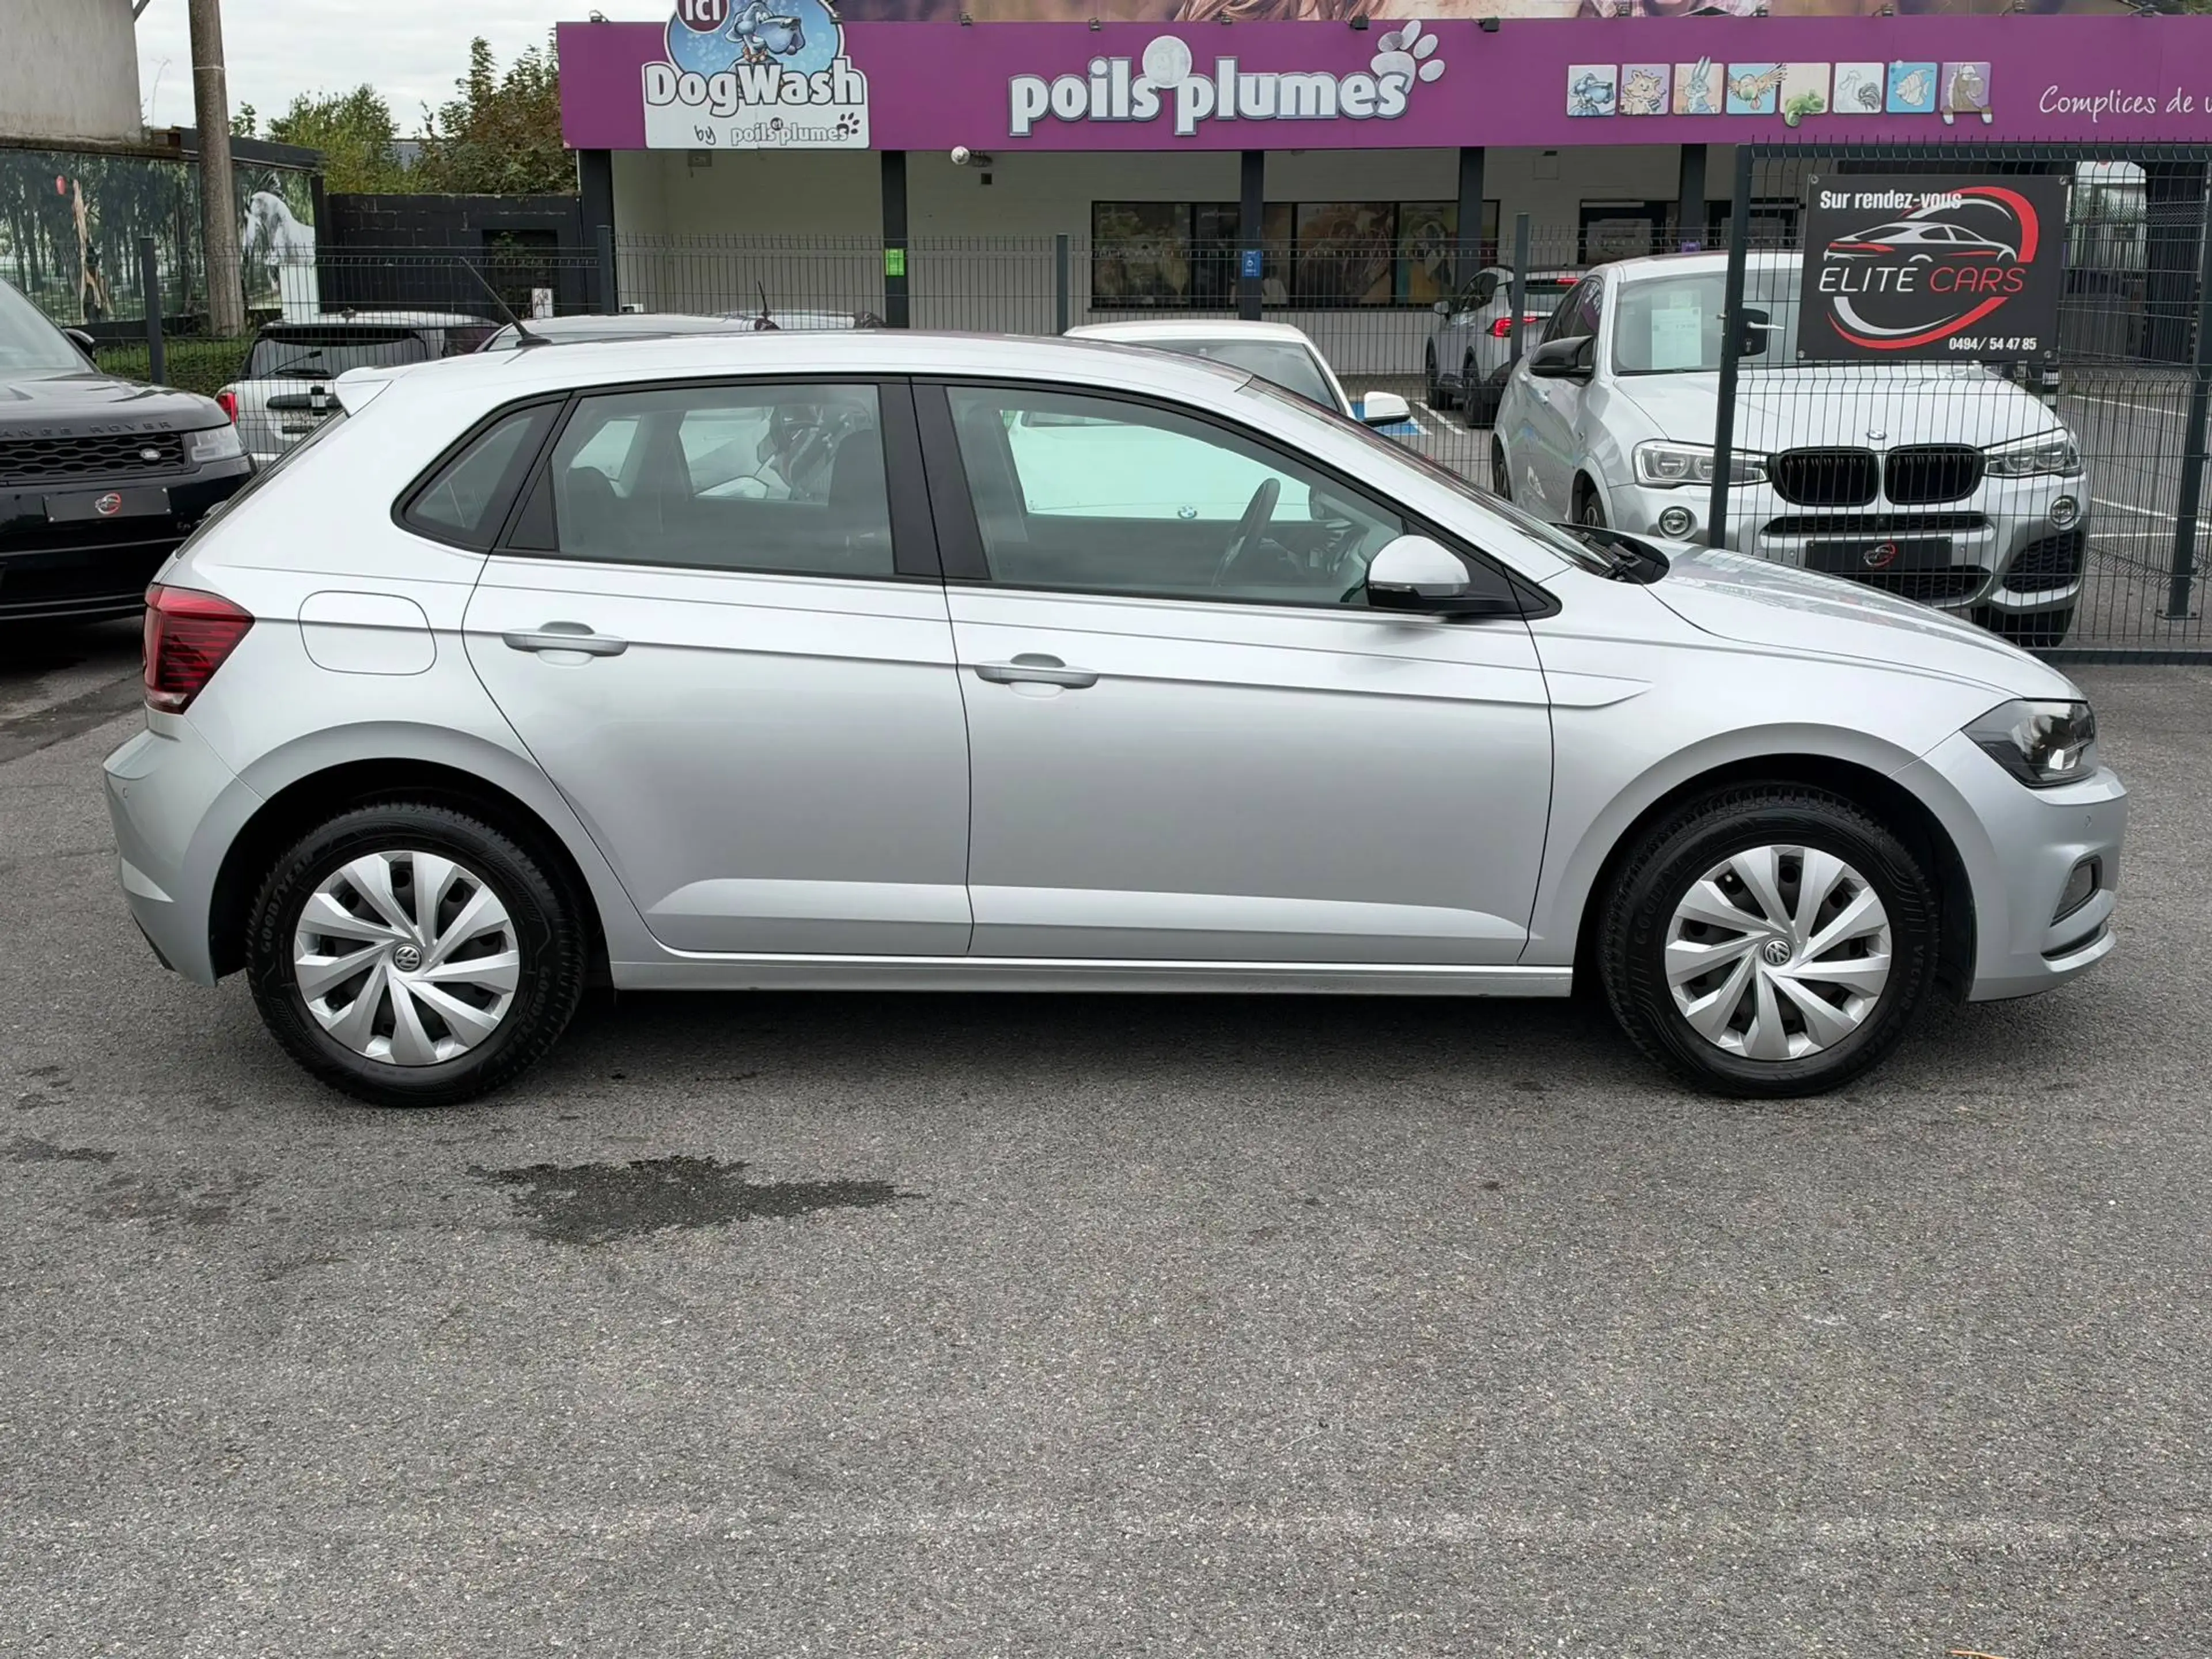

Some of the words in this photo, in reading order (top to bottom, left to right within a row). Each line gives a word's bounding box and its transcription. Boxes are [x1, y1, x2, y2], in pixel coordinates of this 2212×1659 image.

[645, 58, 864, 118] DogWash
[1175, 56, 1409, 137] plumes
[2039, 85, 2157, 123] Complices
[2165, 86, 2195, 113] de
[694, 124, 717, 145] by
[1820, 190, 1851, 209] Sur
[1854, 189, 1962, 209] rendez-vous
[1819, 267, 1919, 293] ELITE
[1930, 267, 2027, 293] CARS
[1989, 337, 2004, 350] 54
[2006, 337, 2021, 350] 47
[2022, 337, 2037, 350] 85
[88, 421, 174, 434] ROVER
